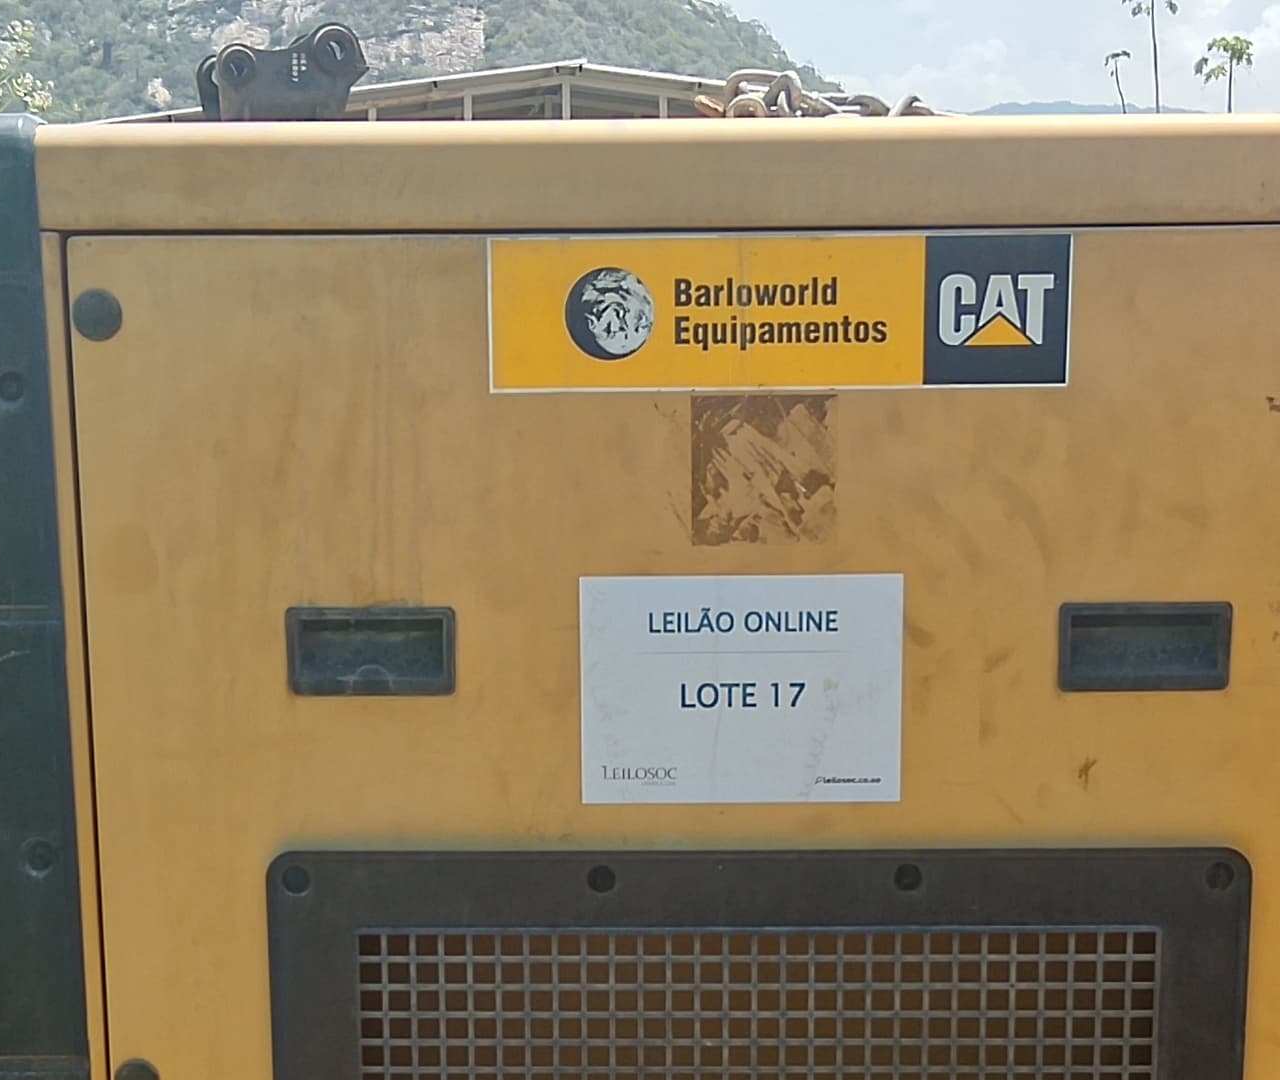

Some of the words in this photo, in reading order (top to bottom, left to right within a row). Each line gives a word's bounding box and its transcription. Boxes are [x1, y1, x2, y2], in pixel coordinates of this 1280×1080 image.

[673, 276, 838, 308] Barloworld
[937, 273, 1055, 346] CAT
[673, 314, 888, 351] Equipamentos
[648, 607, 735, 633] LEILÃO
[744, 610, 839, 633] ONLINE
[680, 682, 757, 708] LOTE
[770, 682, 806, 708] 17
